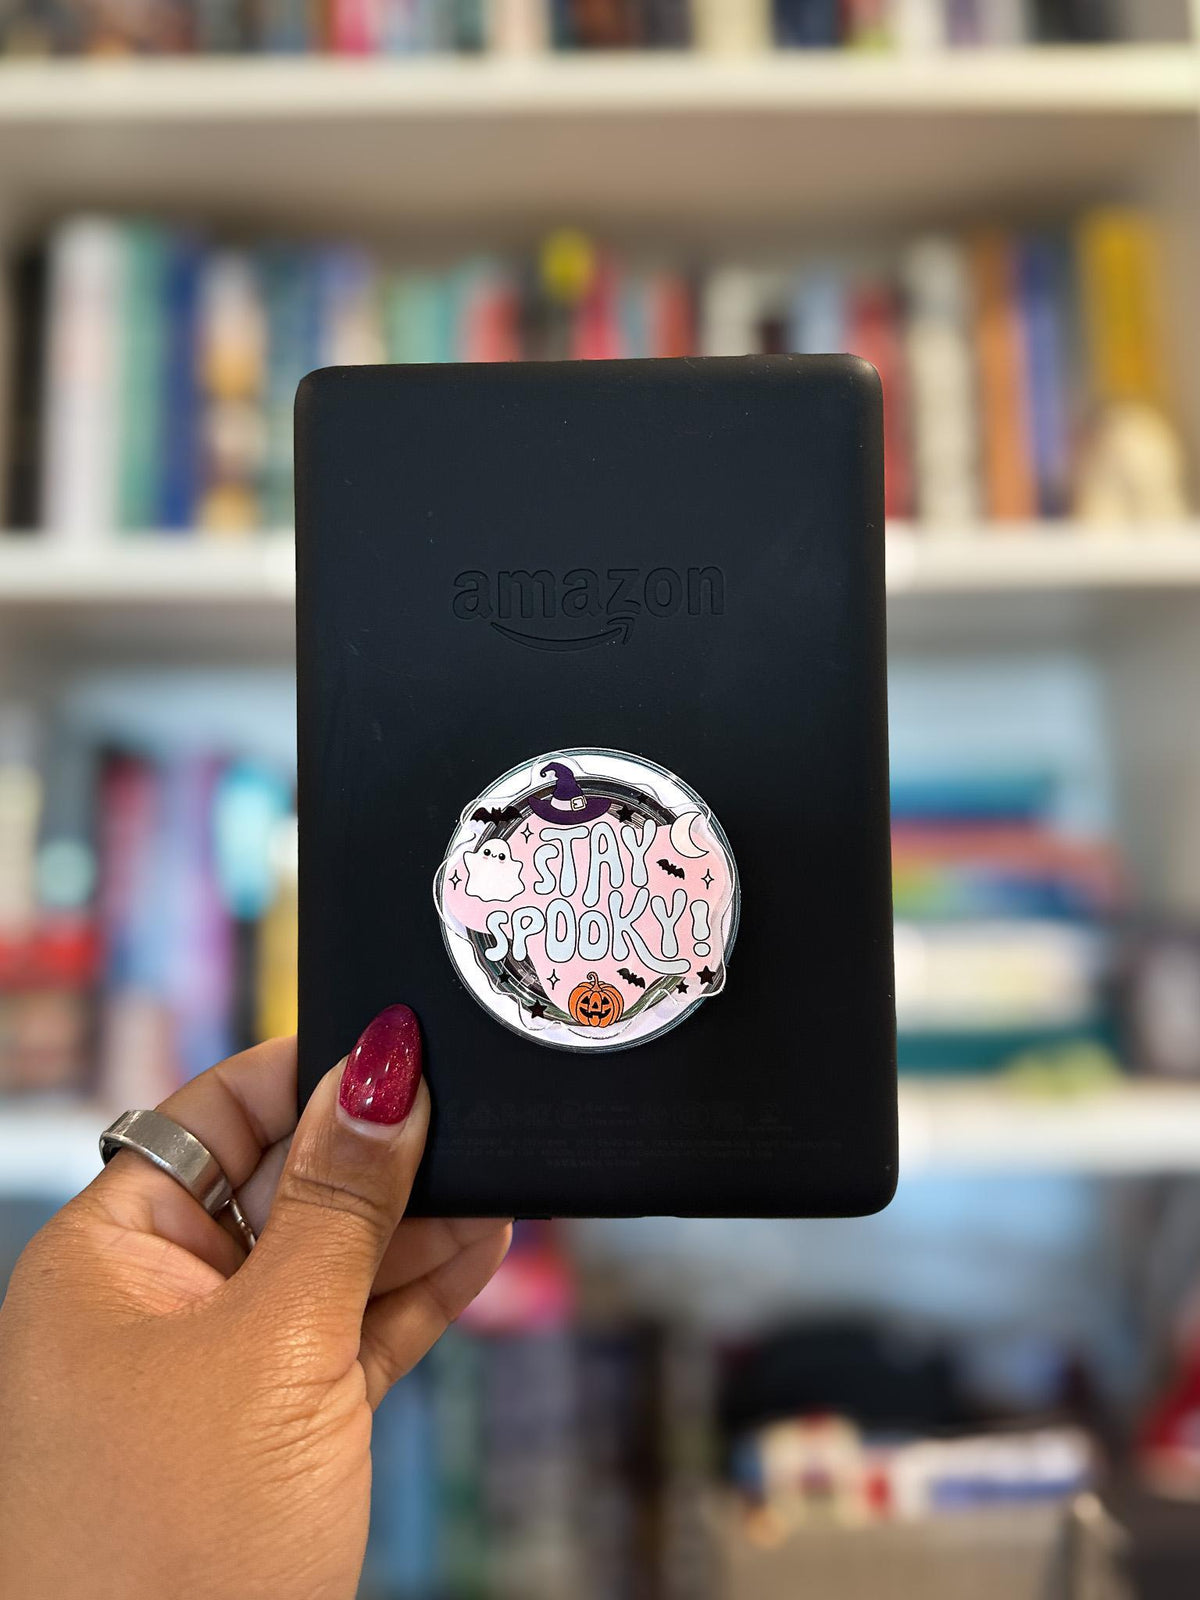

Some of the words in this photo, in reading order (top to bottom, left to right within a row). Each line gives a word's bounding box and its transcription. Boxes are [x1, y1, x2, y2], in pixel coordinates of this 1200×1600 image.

[452, 566, 724, 620] amazon
[533, 819, 657, 908] STAY
[485, 887, 711, 975] SPOOKY!
